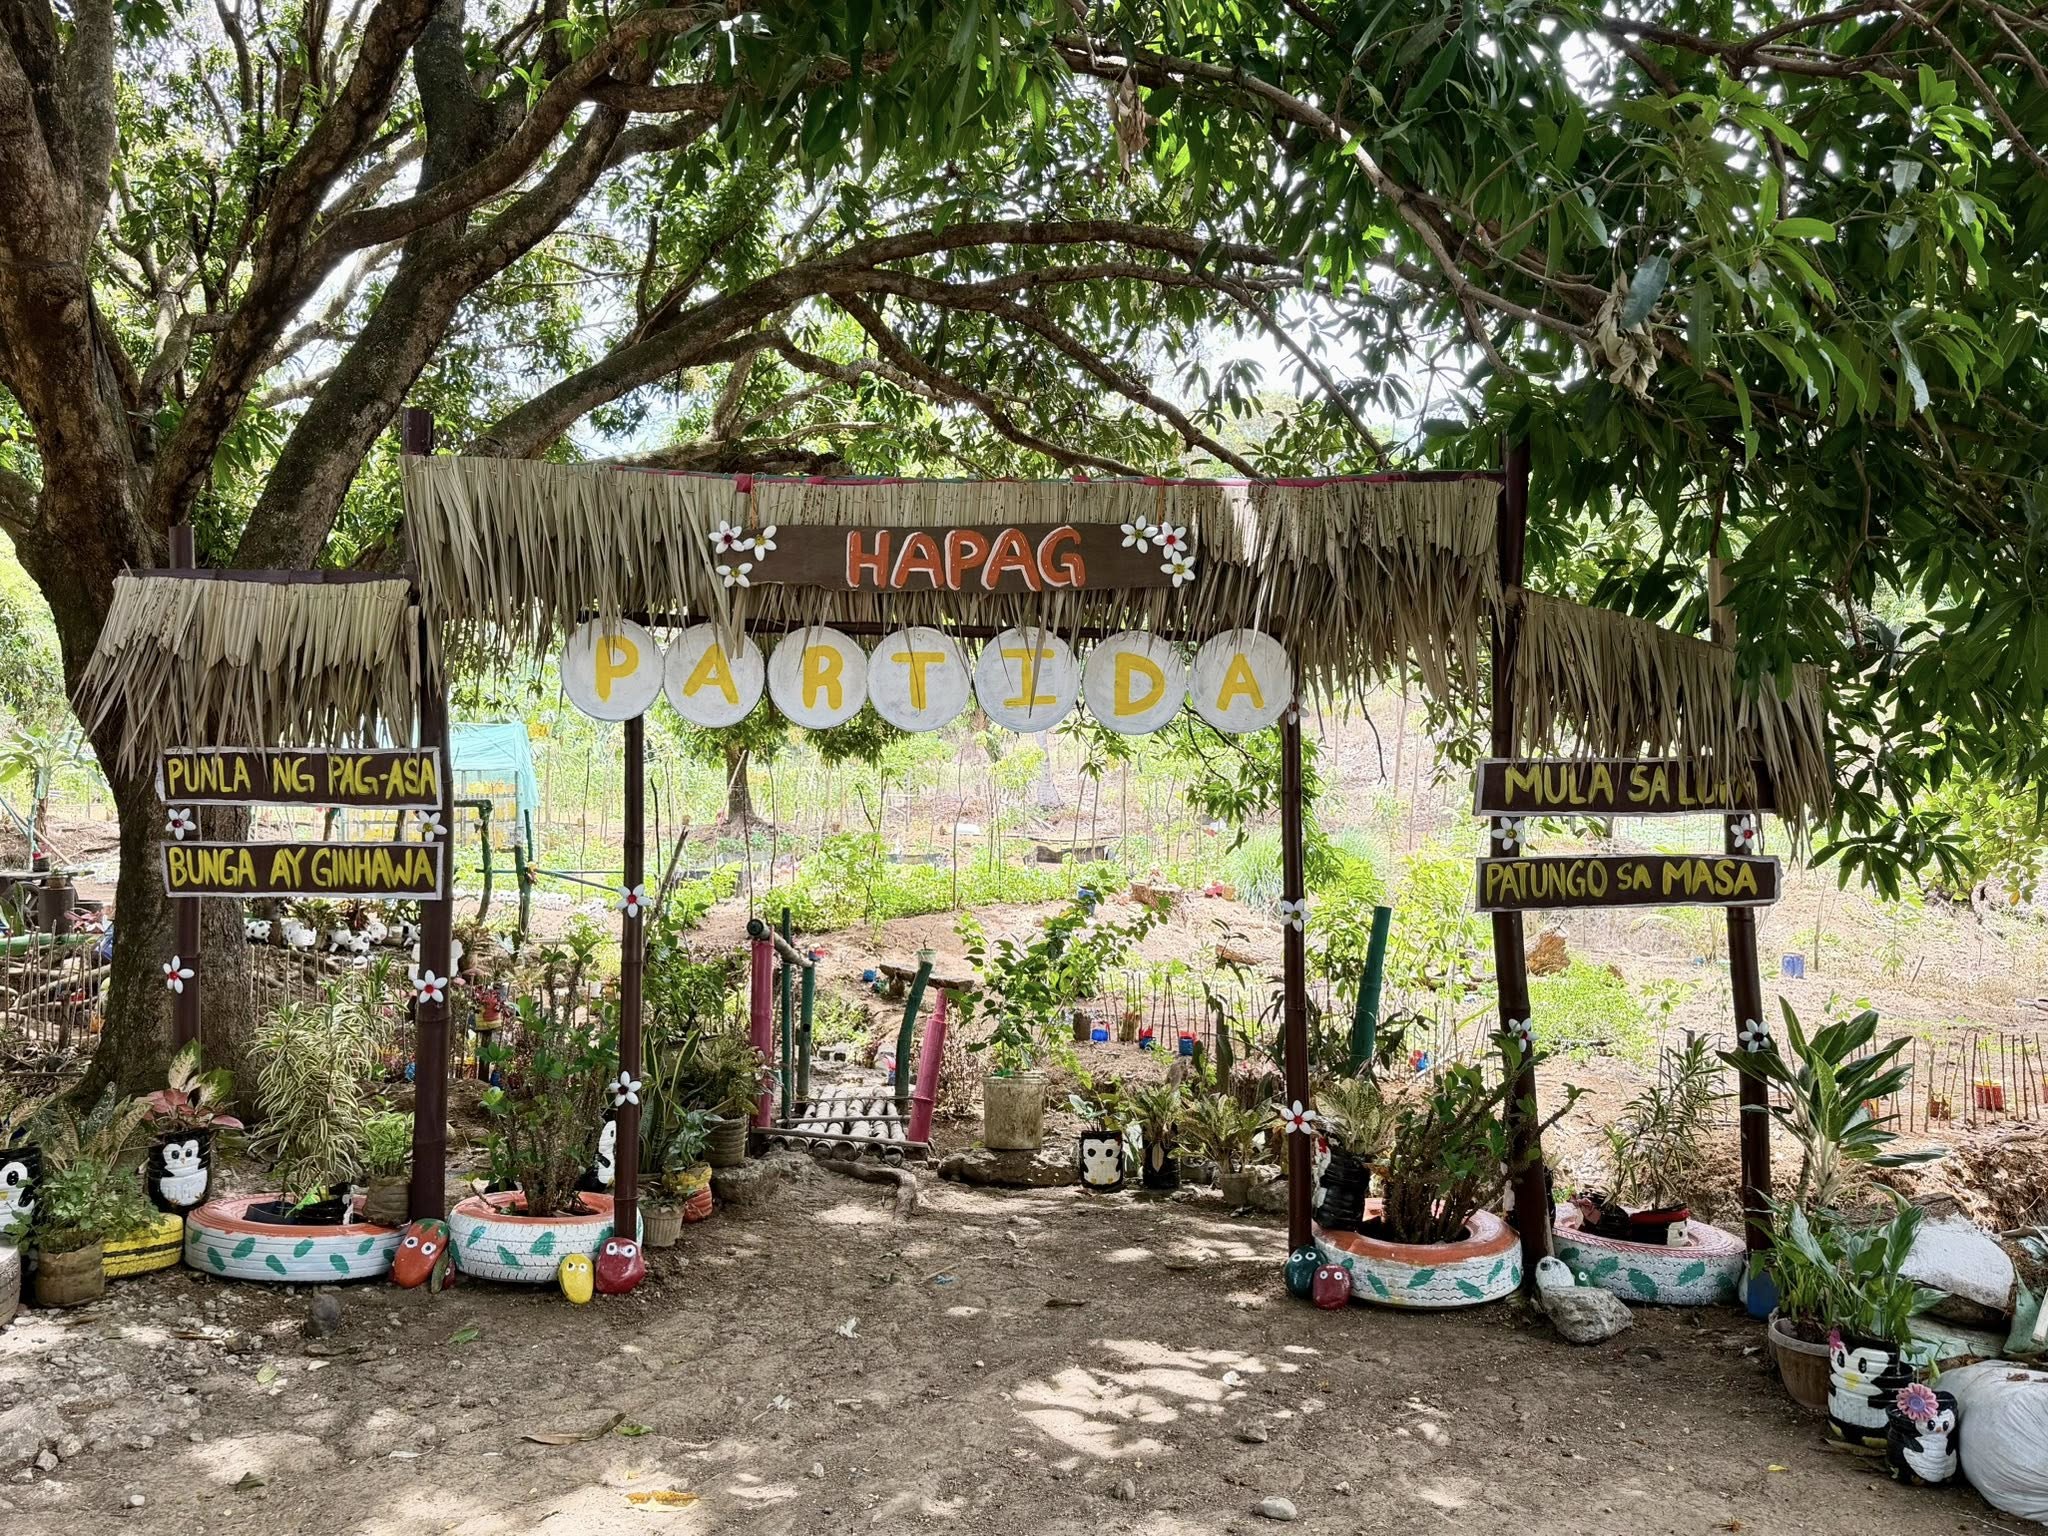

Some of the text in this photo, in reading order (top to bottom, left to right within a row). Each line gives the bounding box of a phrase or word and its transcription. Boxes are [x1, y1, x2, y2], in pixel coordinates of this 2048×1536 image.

[846, 525, 1085, 591] HAPAG
[594, 634, 1265, 717] PARTIDA
[167, 755, 437, 799] PUNLA NG PAG-ASA
[1504, 763, 1614, 805] MULA
[1627, 765, 1671, 806] SA
[168, 846, 435, 889] BUNGA AY GINHAWA
[1486, 859, 1609, 902] PATUNGO
[1662, 858, 1758, 896] MASA
